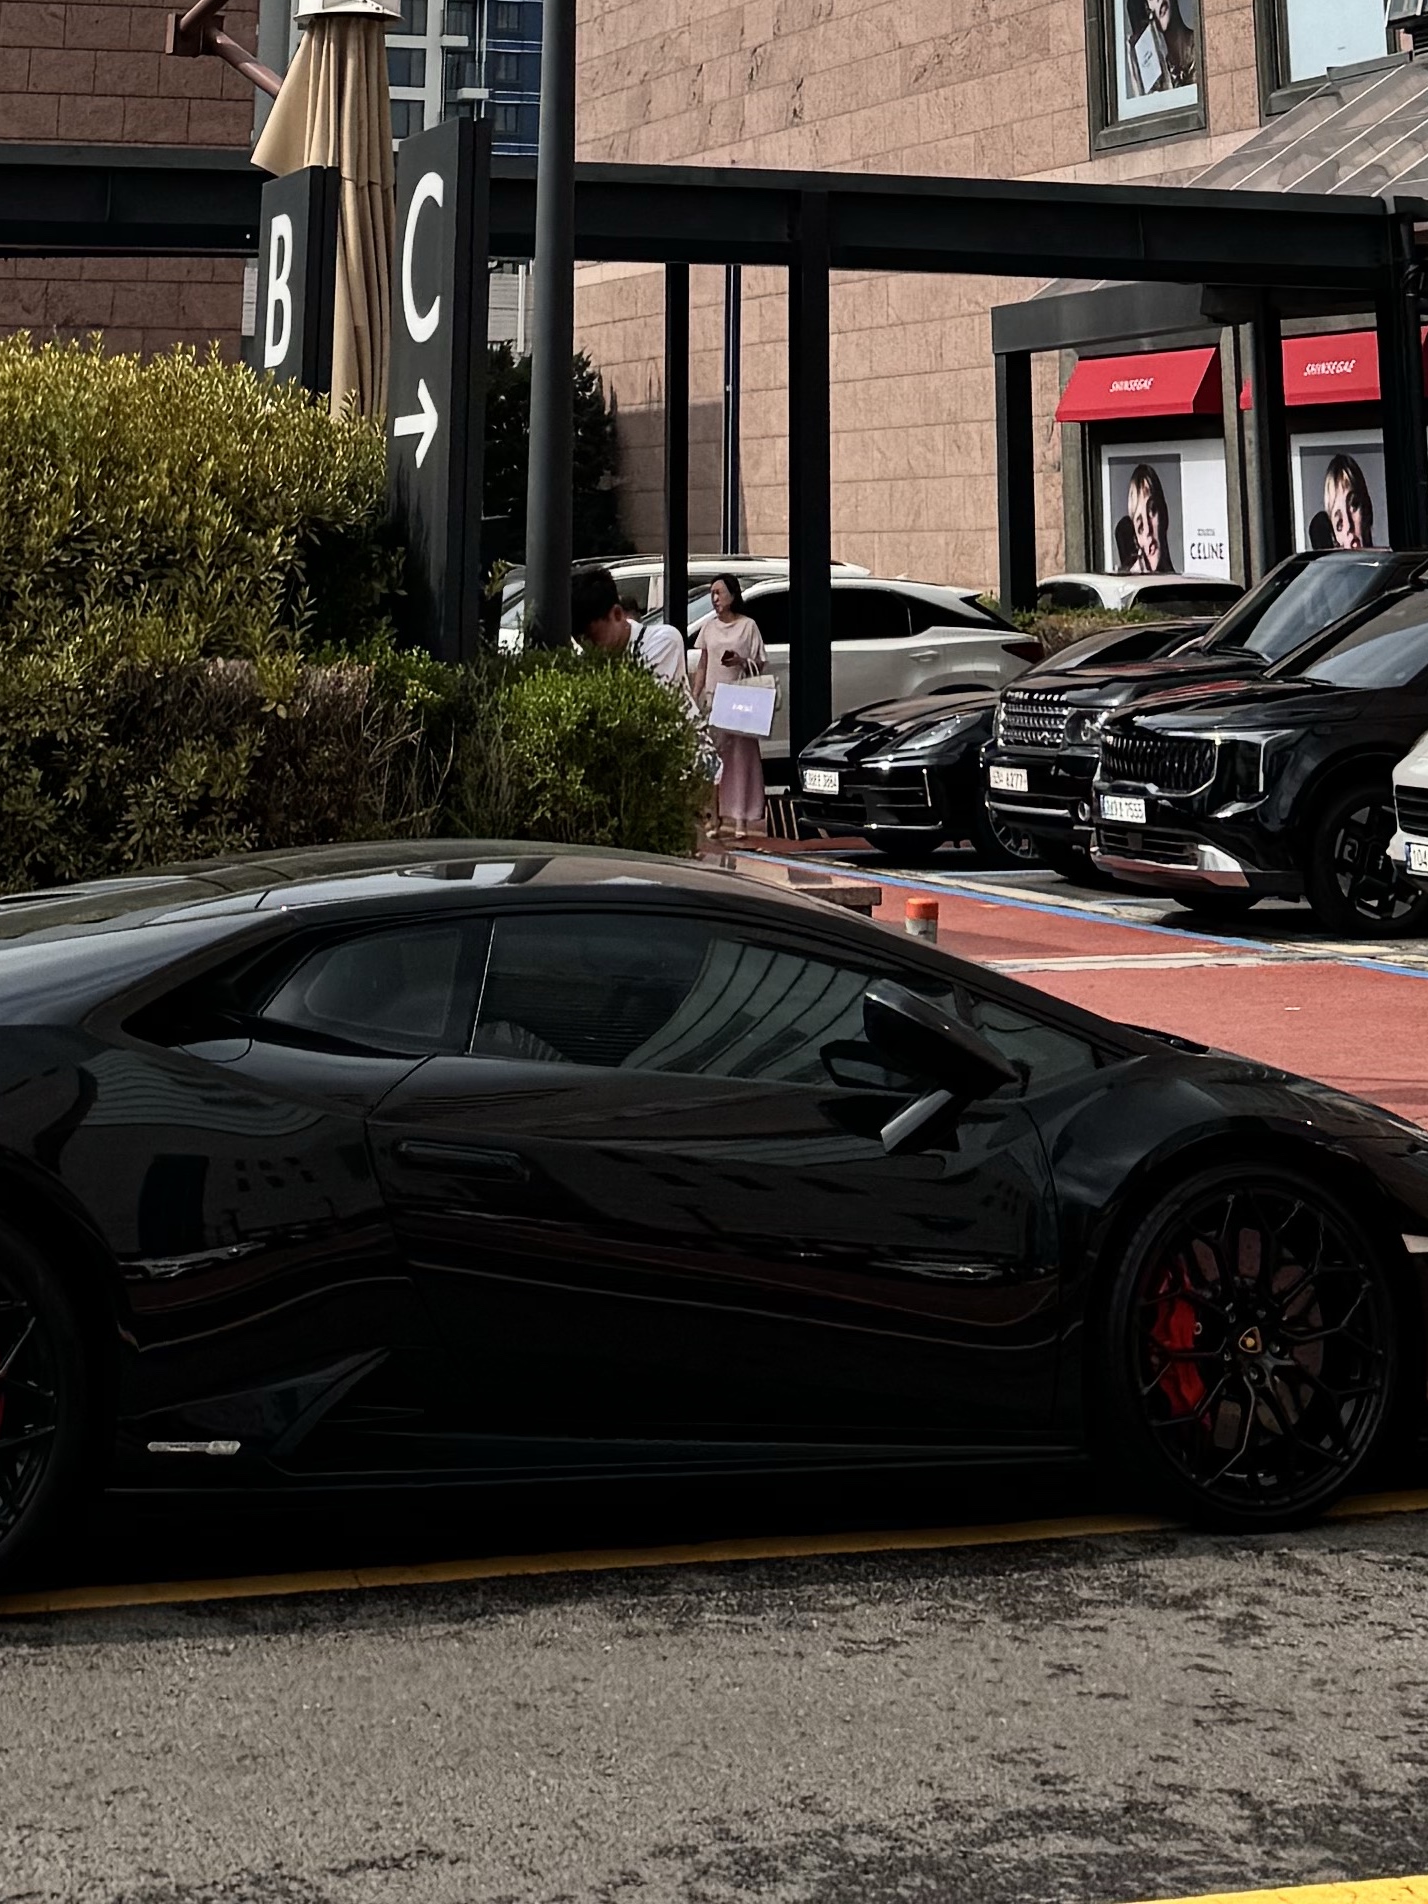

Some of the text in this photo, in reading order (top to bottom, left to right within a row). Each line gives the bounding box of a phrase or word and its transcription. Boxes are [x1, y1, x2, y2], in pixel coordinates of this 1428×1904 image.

[264, 213, 293, 368] B
[402, 171, 444, 343] C
[1190, 542, 1225, 560] CELINE
